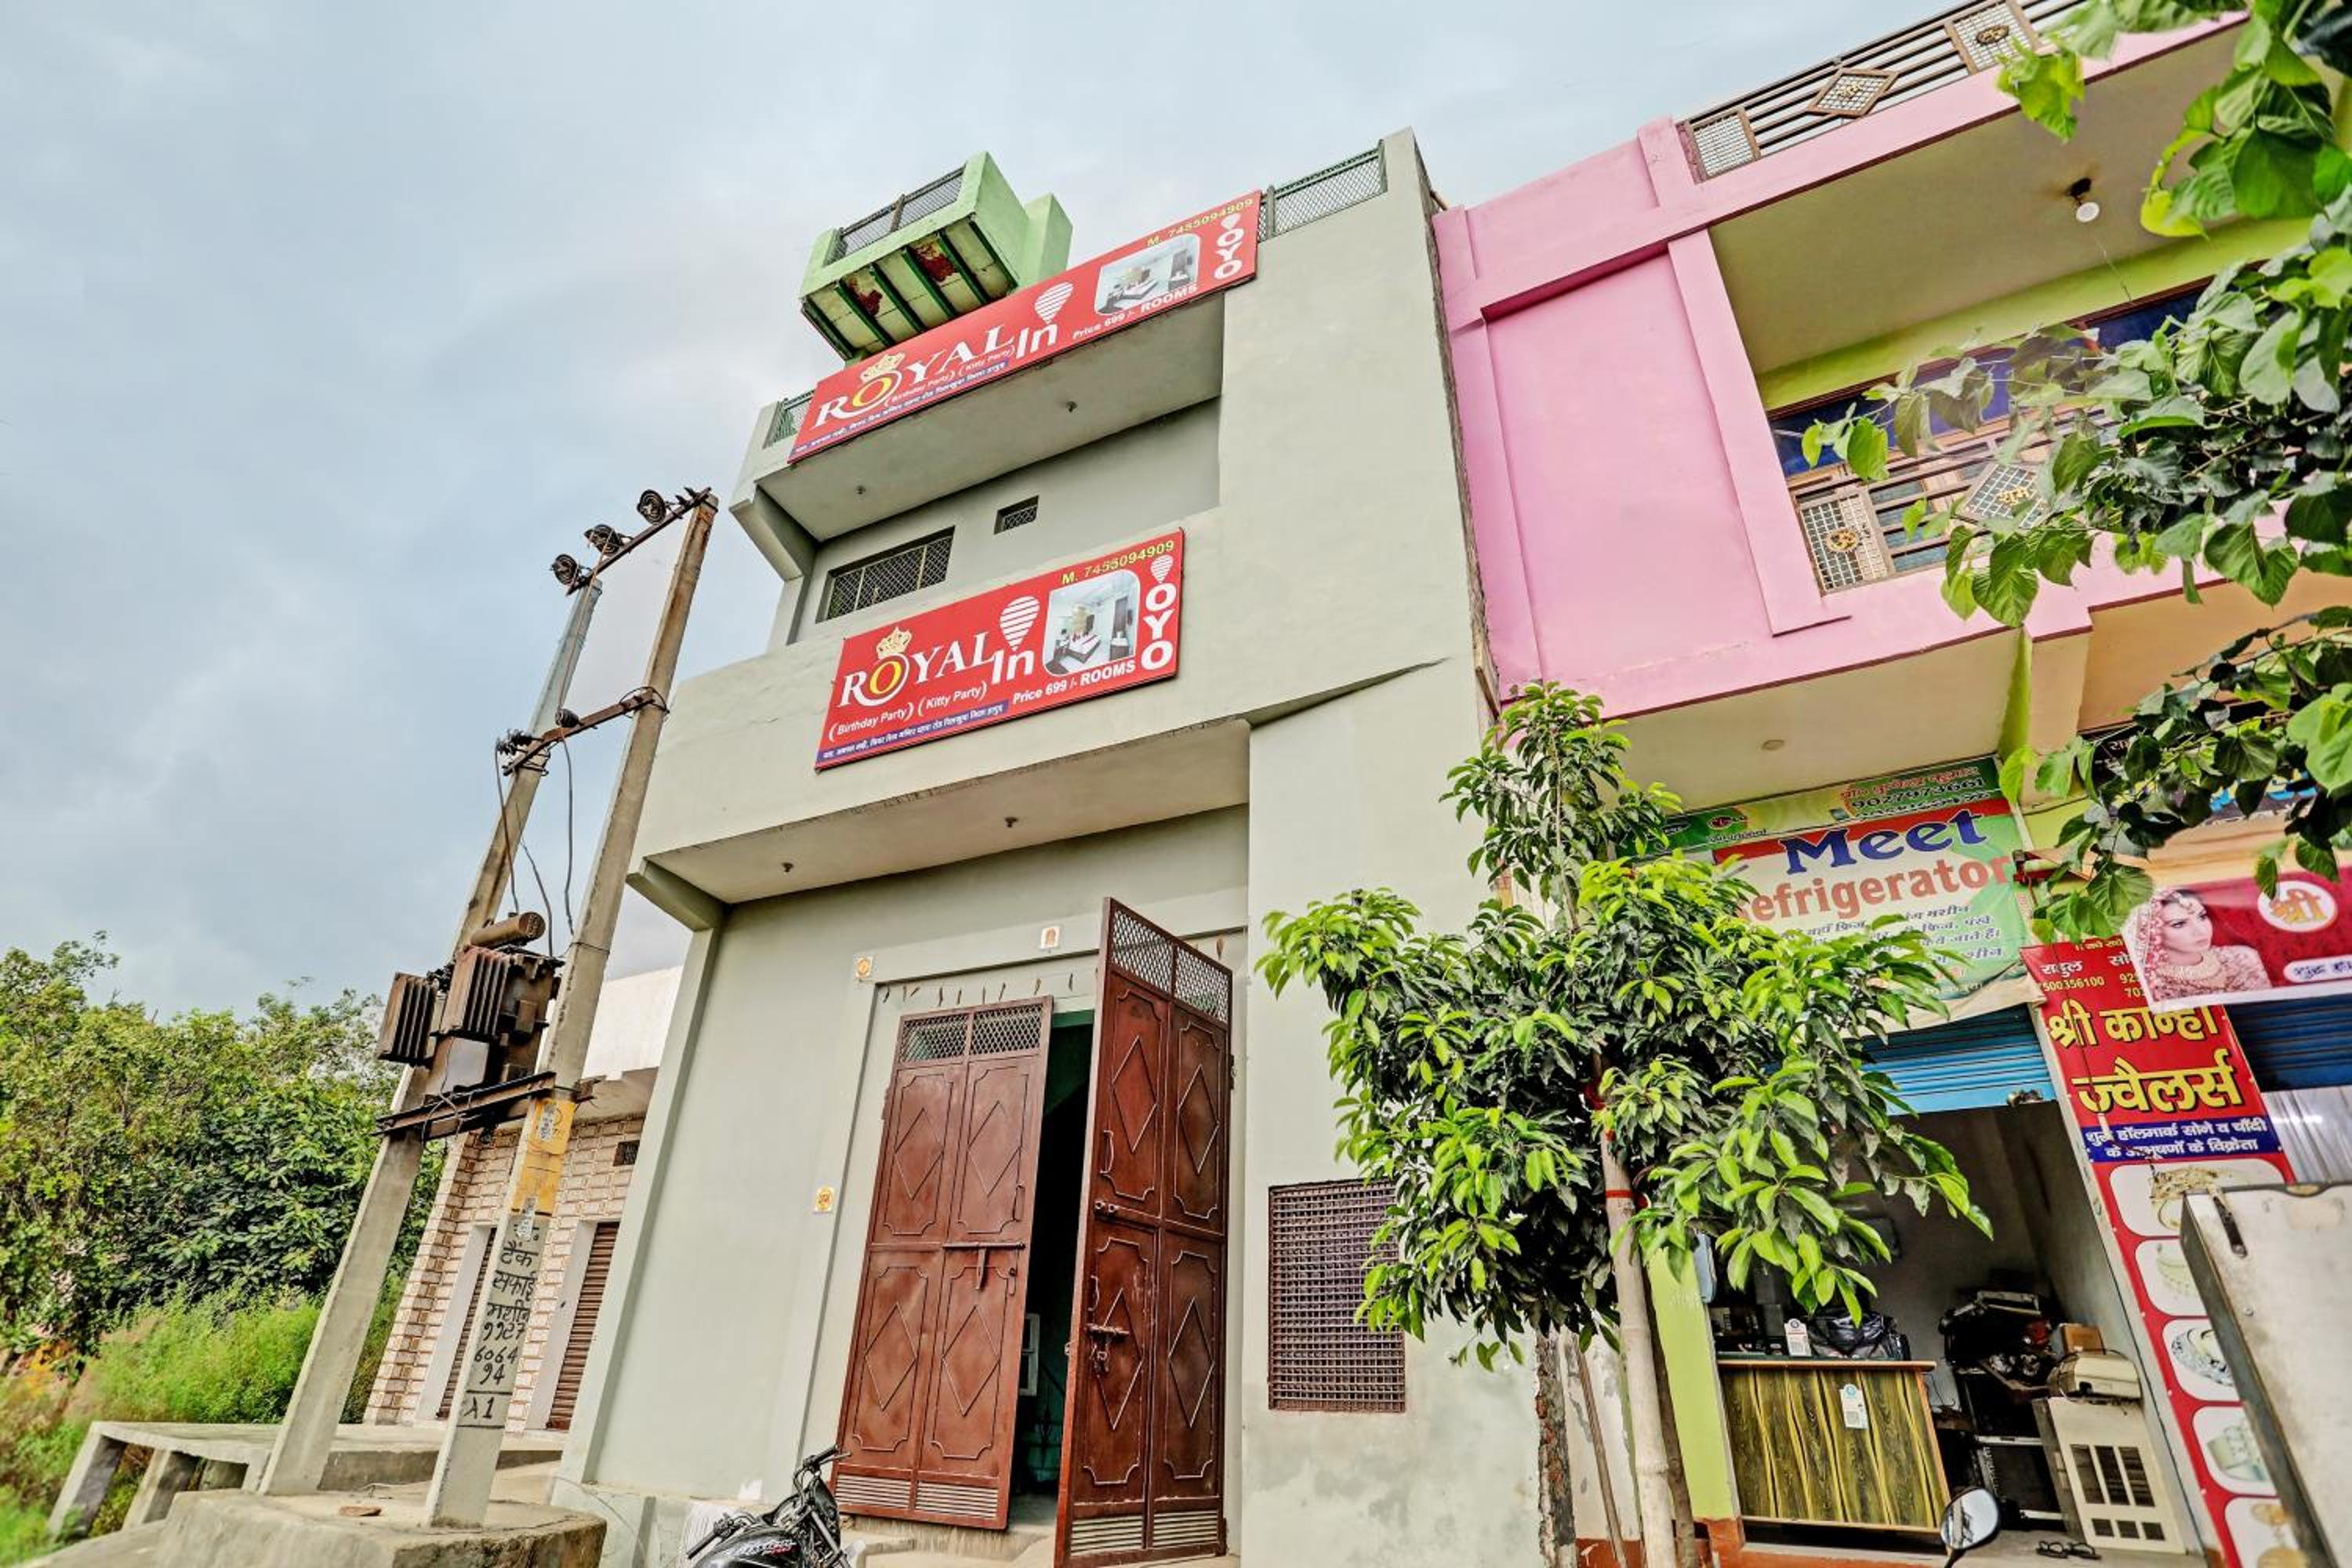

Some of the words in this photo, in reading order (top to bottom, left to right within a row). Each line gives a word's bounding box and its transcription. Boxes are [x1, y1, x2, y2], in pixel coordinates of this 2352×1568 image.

[1214, 227, 1245, 281] OYO
[1072, 323, 1102, 339] Price
[1141, 283, 1198, 314] ROOMS
[813, 324, 1014, 428] ROYAL
[1016, 324, 1058, 360] In
[1062, 571, 1079, 584] M.
[1083, 540, 1174, 577] 7455094909
[1141, 583, 1177, 671] OYO
[839, 631, 996, 706] ROYAL
[991, 649, 1035, 685] In
[1012, 688, 1043, 704] Price
[1045, 680, 1067, 695] 699
[1080, 660, 1136, 686] ROOMS
[953, 680, 988, 702] Party)
[1779, 809, 1987, 876] Meet
[1738, 855, 2014, 922] efrigerator
[2048, 999, 2098, 1049] श्री
[2099, 1004, 2218, 1043] कान्हा
[2071, 1047, 2243, 1113] ज्वैलर्स
[2103, 1144, 2122, 1158] के
[2186, 1138, 2205, 1153] के
[2206, 1136, 2259, 1154] विक्रेता
[2215, 1122, 2230, 1134] व
[500, 1240, 540, 1268] टैंक
[492, 1269, 539, 1302] सफाई
[486, 1298, 532, 1323] मशीन
[474, 1345, 518, 1364] 6064
[479, 1362, 506, 1386] 94
